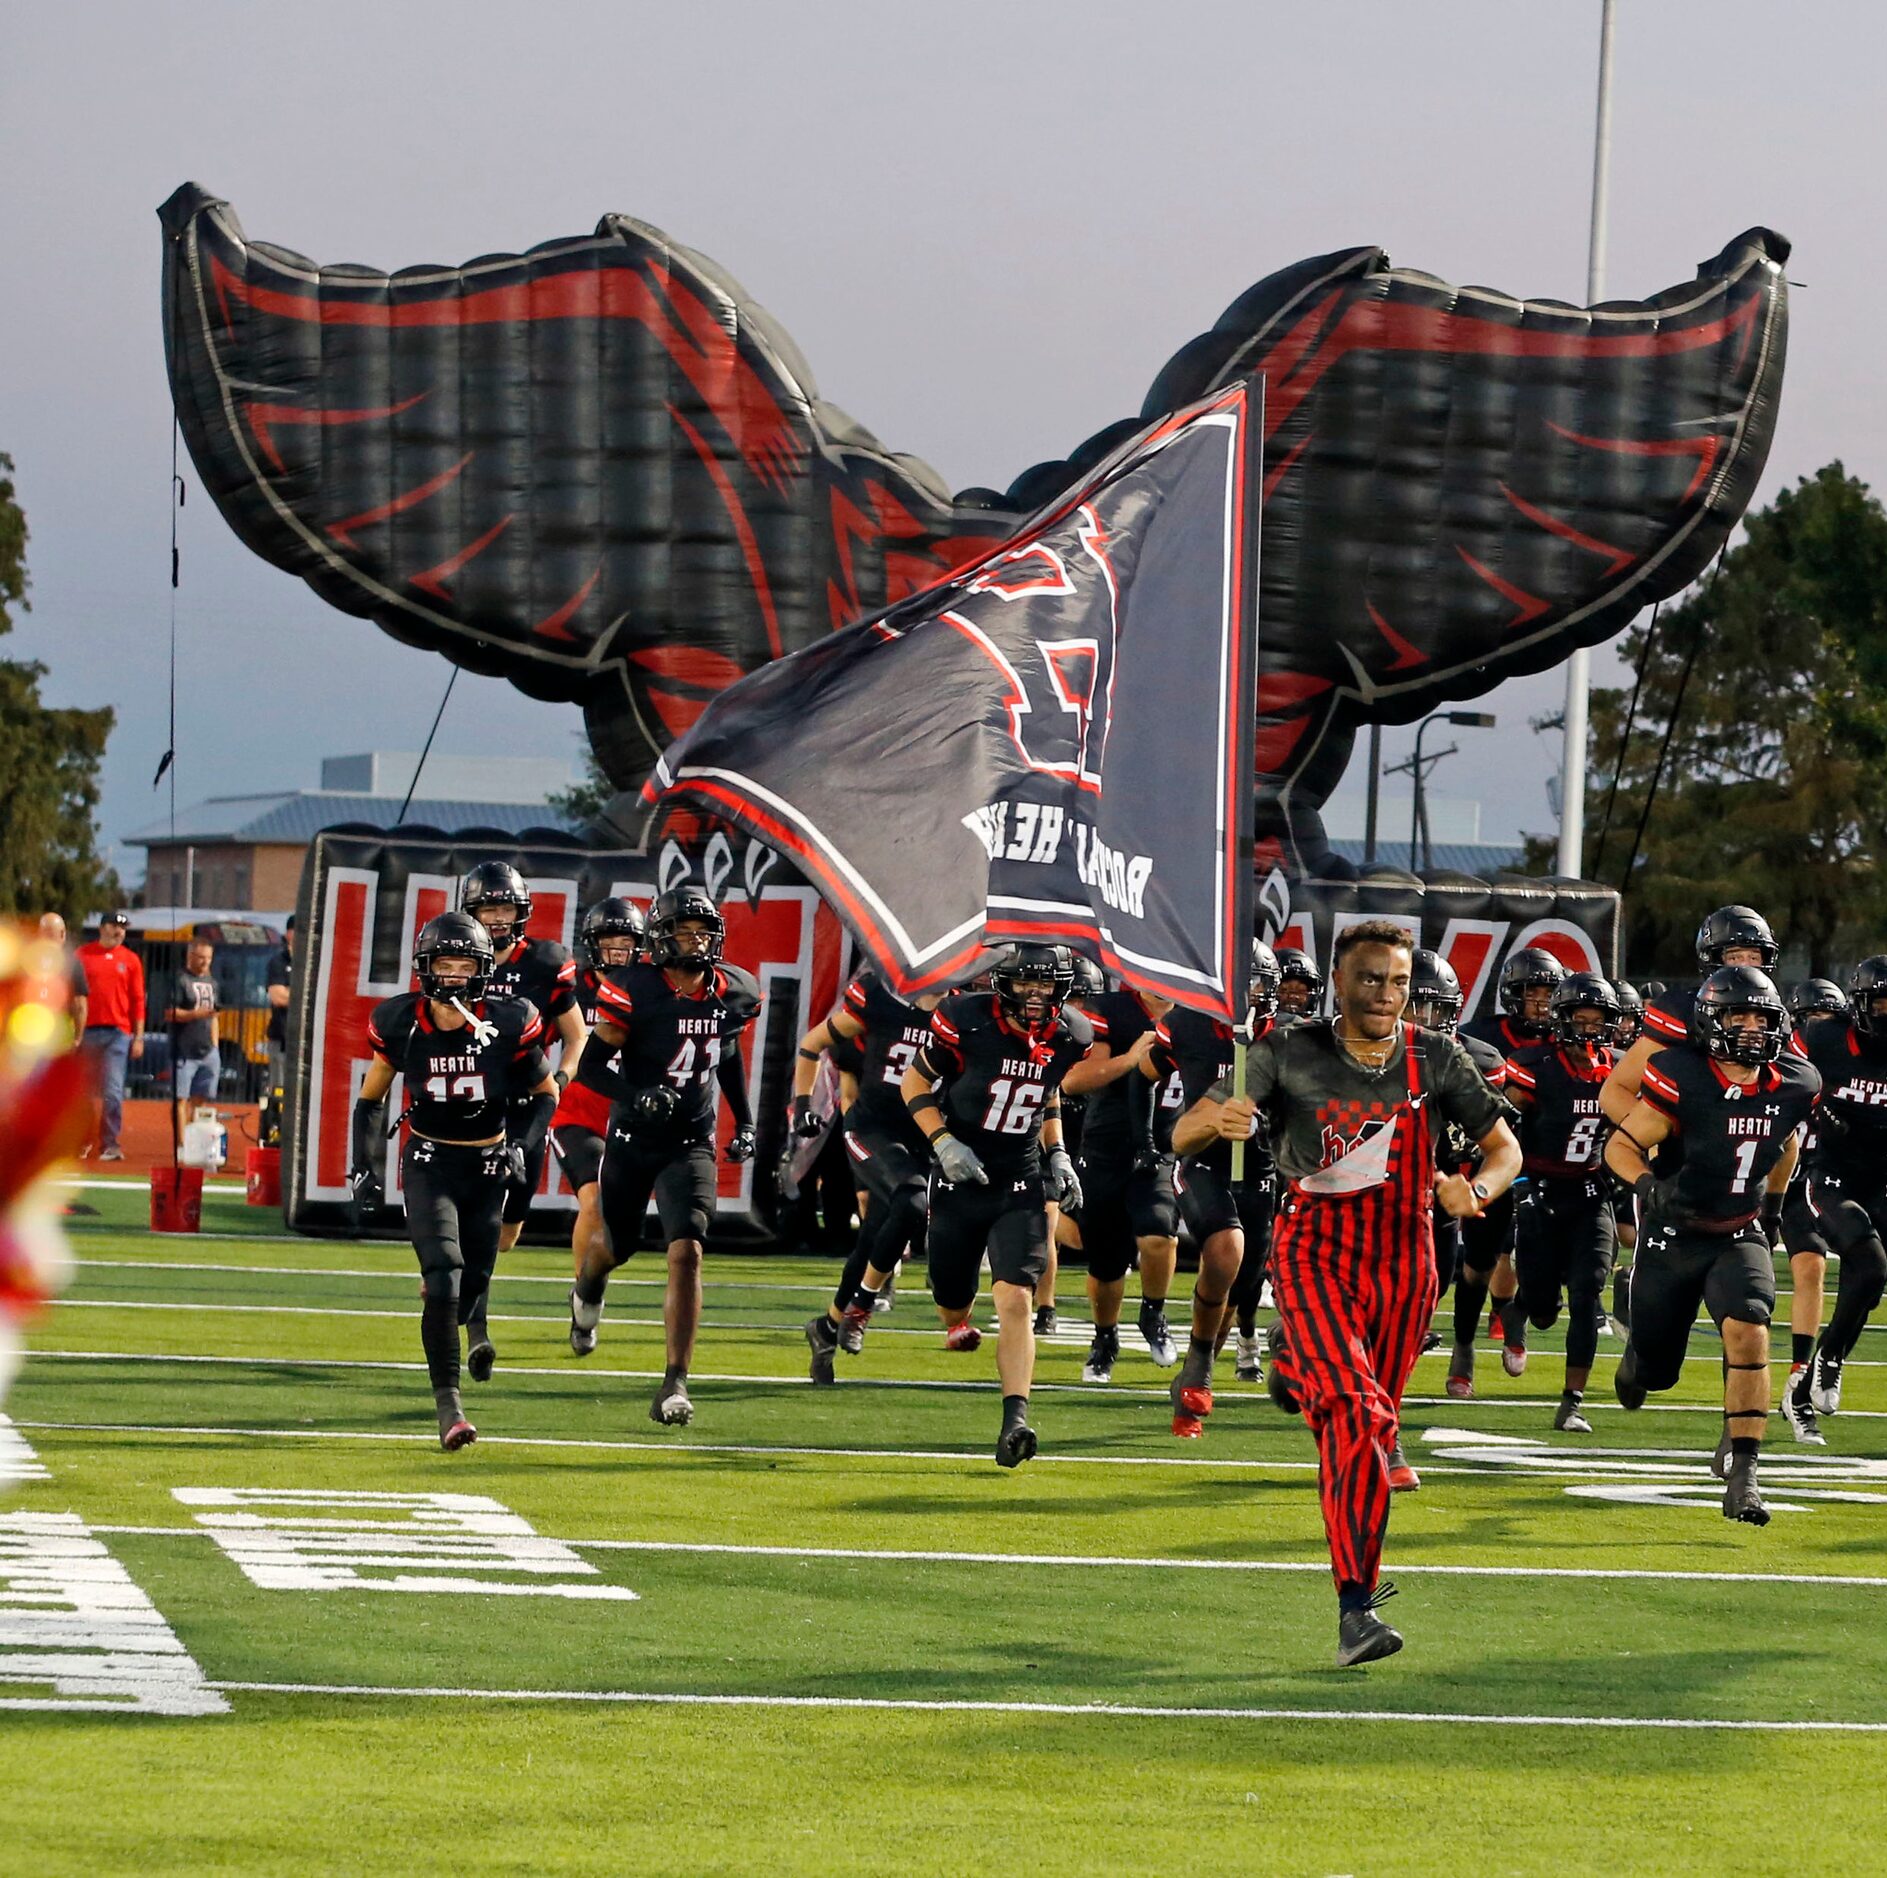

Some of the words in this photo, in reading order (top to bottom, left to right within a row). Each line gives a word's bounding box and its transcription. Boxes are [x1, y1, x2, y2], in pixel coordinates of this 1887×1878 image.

[679, 1019, 719, 1035] HEATH
[903, 1026, 935, 1044] HEAT
[429, 1056, 476, 1073] HEATH
[666, 1037, 722, 1088] 41
[1001, 1058, 1045, 1081] HEATH
[983, 1079, 1045, 1135] 16
[1572, 1099, 1605, 1113] HEAT
[1727, 1117, 1772, 1136] HEATH
[482, 1161, 498, 1175] H
[1731, 1140, 1758, 1193] 1
[1585, 1183, 1598, 1197] H
